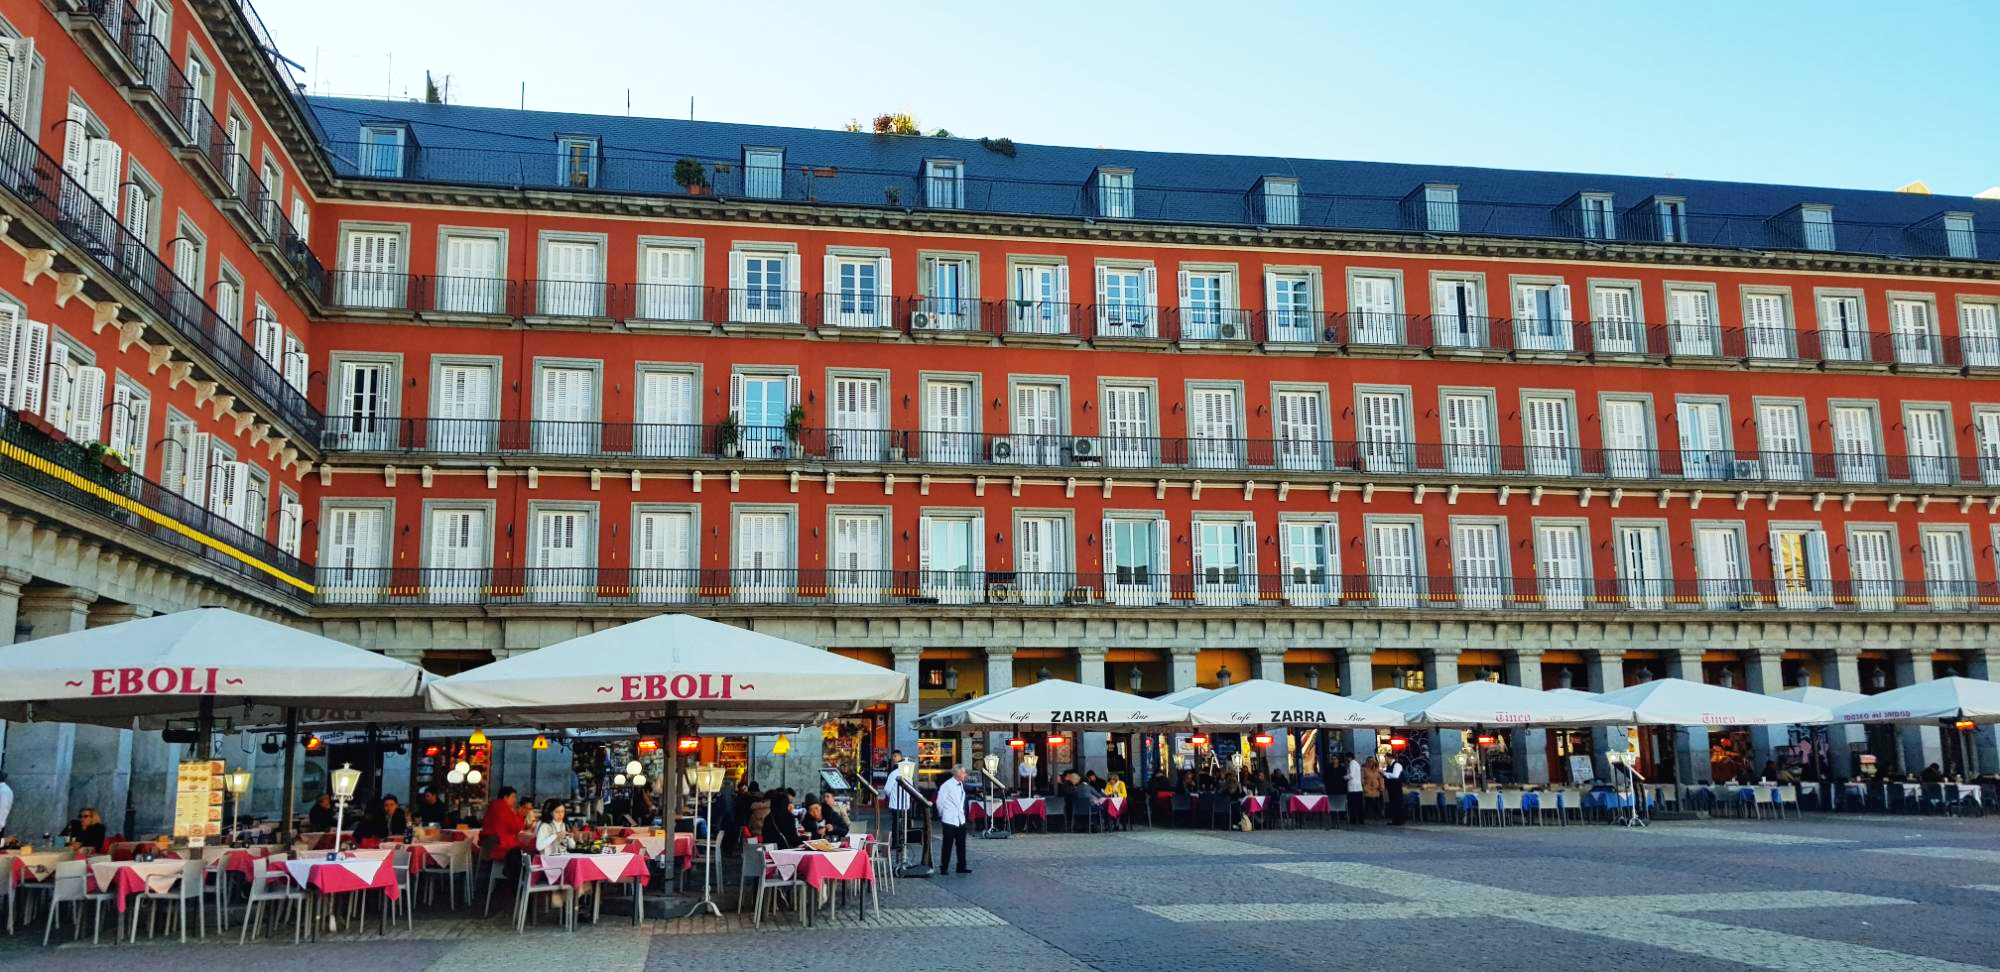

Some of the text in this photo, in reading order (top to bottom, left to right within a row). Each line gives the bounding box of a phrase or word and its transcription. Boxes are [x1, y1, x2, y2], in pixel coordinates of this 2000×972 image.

[1050, 710, 1109, 723] ZARRA
[1127, 710, 1149, 720] Bar
[1270, 710, 1327, 723] ZARRA
[1344, 711, 1366, 722] Bar
